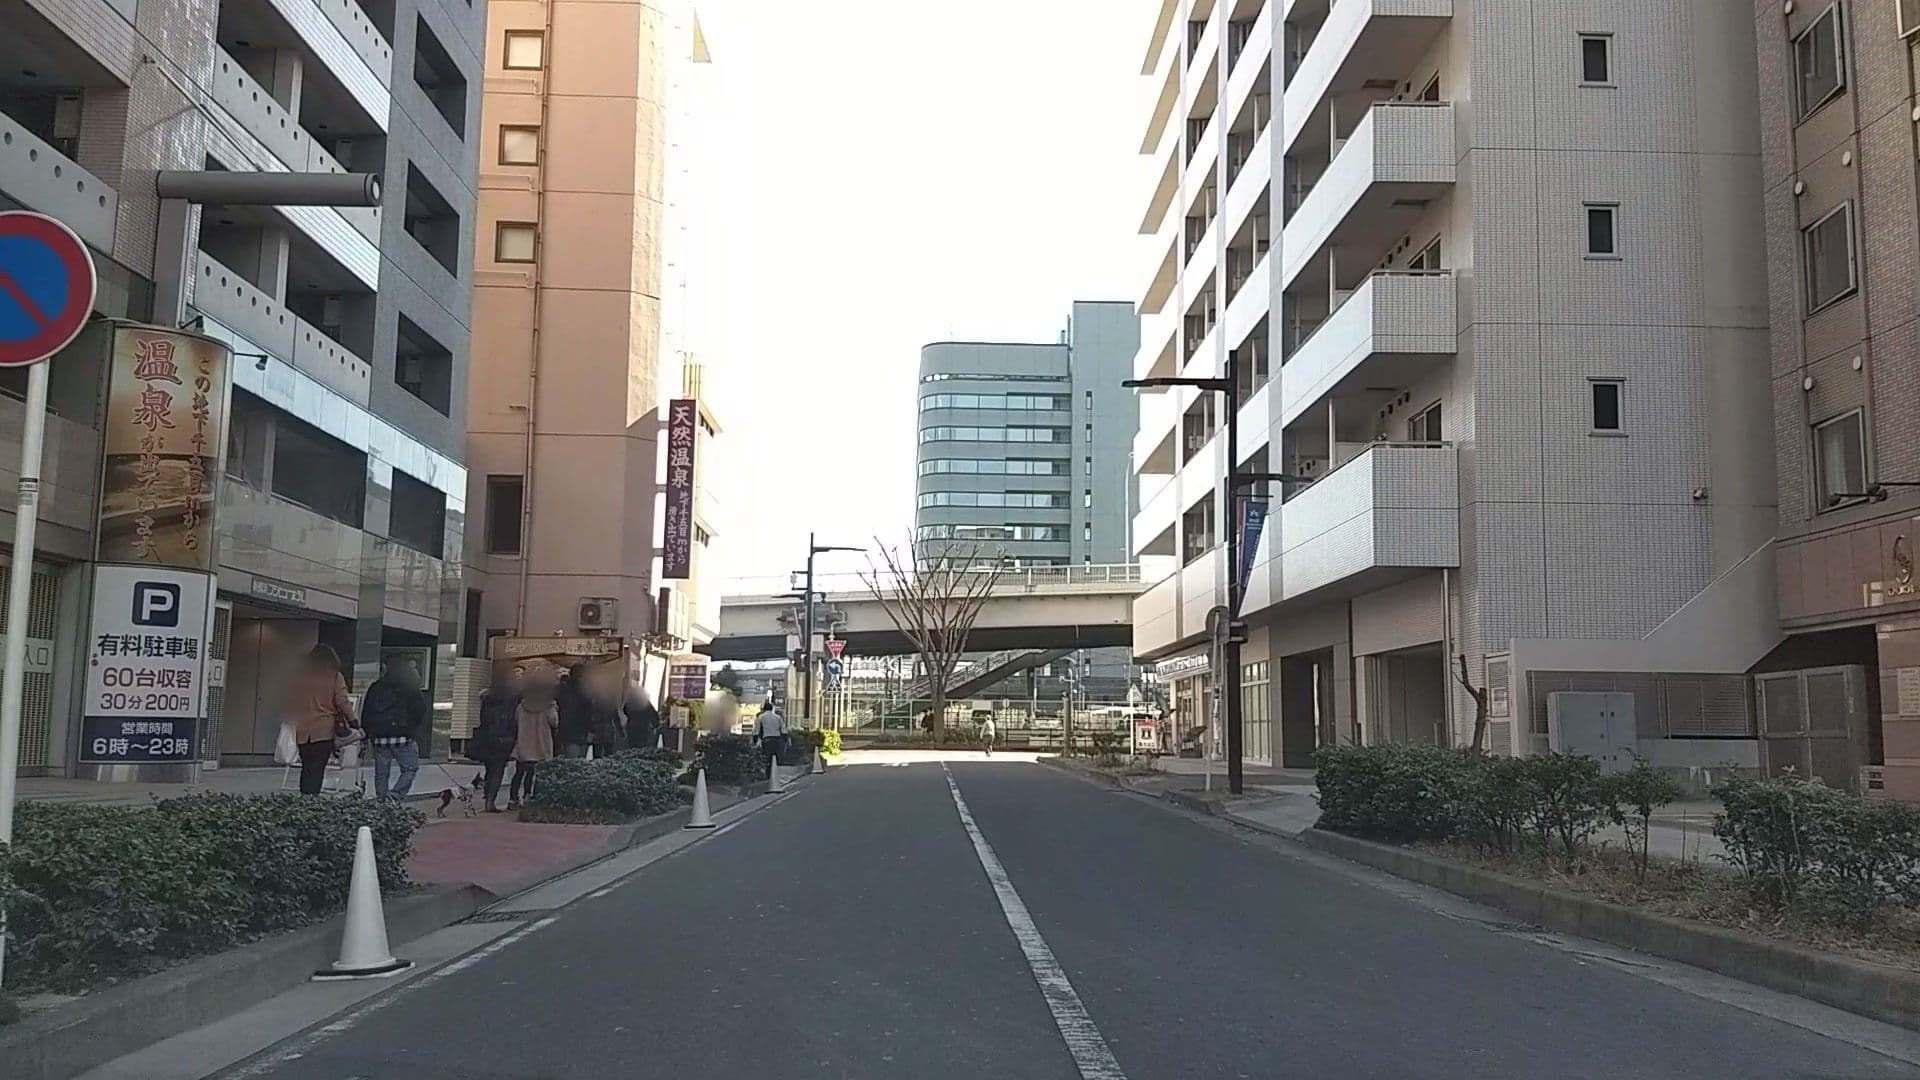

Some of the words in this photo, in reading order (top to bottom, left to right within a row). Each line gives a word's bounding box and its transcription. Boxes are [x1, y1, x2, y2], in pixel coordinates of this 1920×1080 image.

[671, 405, 693, 489] 天然温泉
[141, 588, 174, 620] P
[97, 633, 199, 660] 有料駐車場
[103, 667, 192, 689] 60台収容
[121, 721, 174, 736] 営業時間
